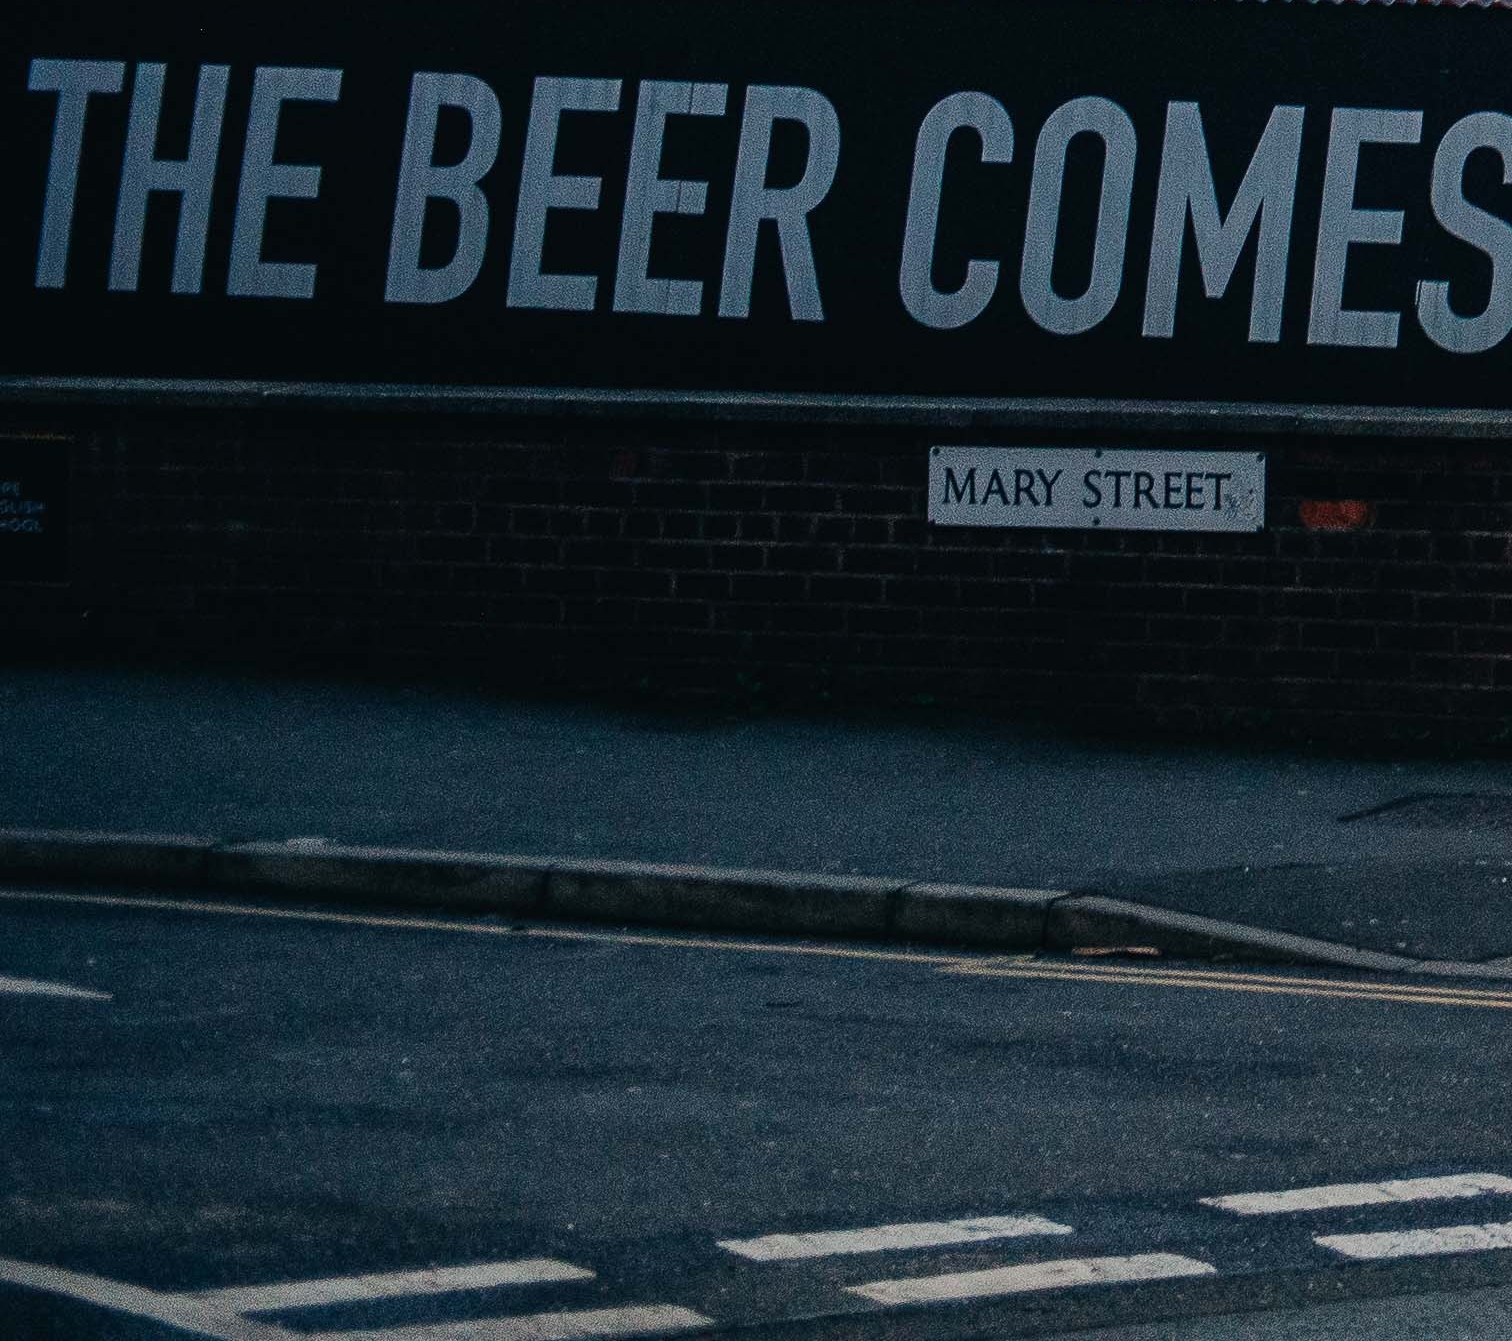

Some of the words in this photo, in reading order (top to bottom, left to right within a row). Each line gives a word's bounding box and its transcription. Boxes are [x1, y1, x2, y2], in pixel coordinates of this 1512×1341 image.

[28, 58, 344, 299] THE
[384, 71, 841, 321] BEER
[943, 467, 1063, 507] MARY
[1082, 470, 1233, 511] STREET
